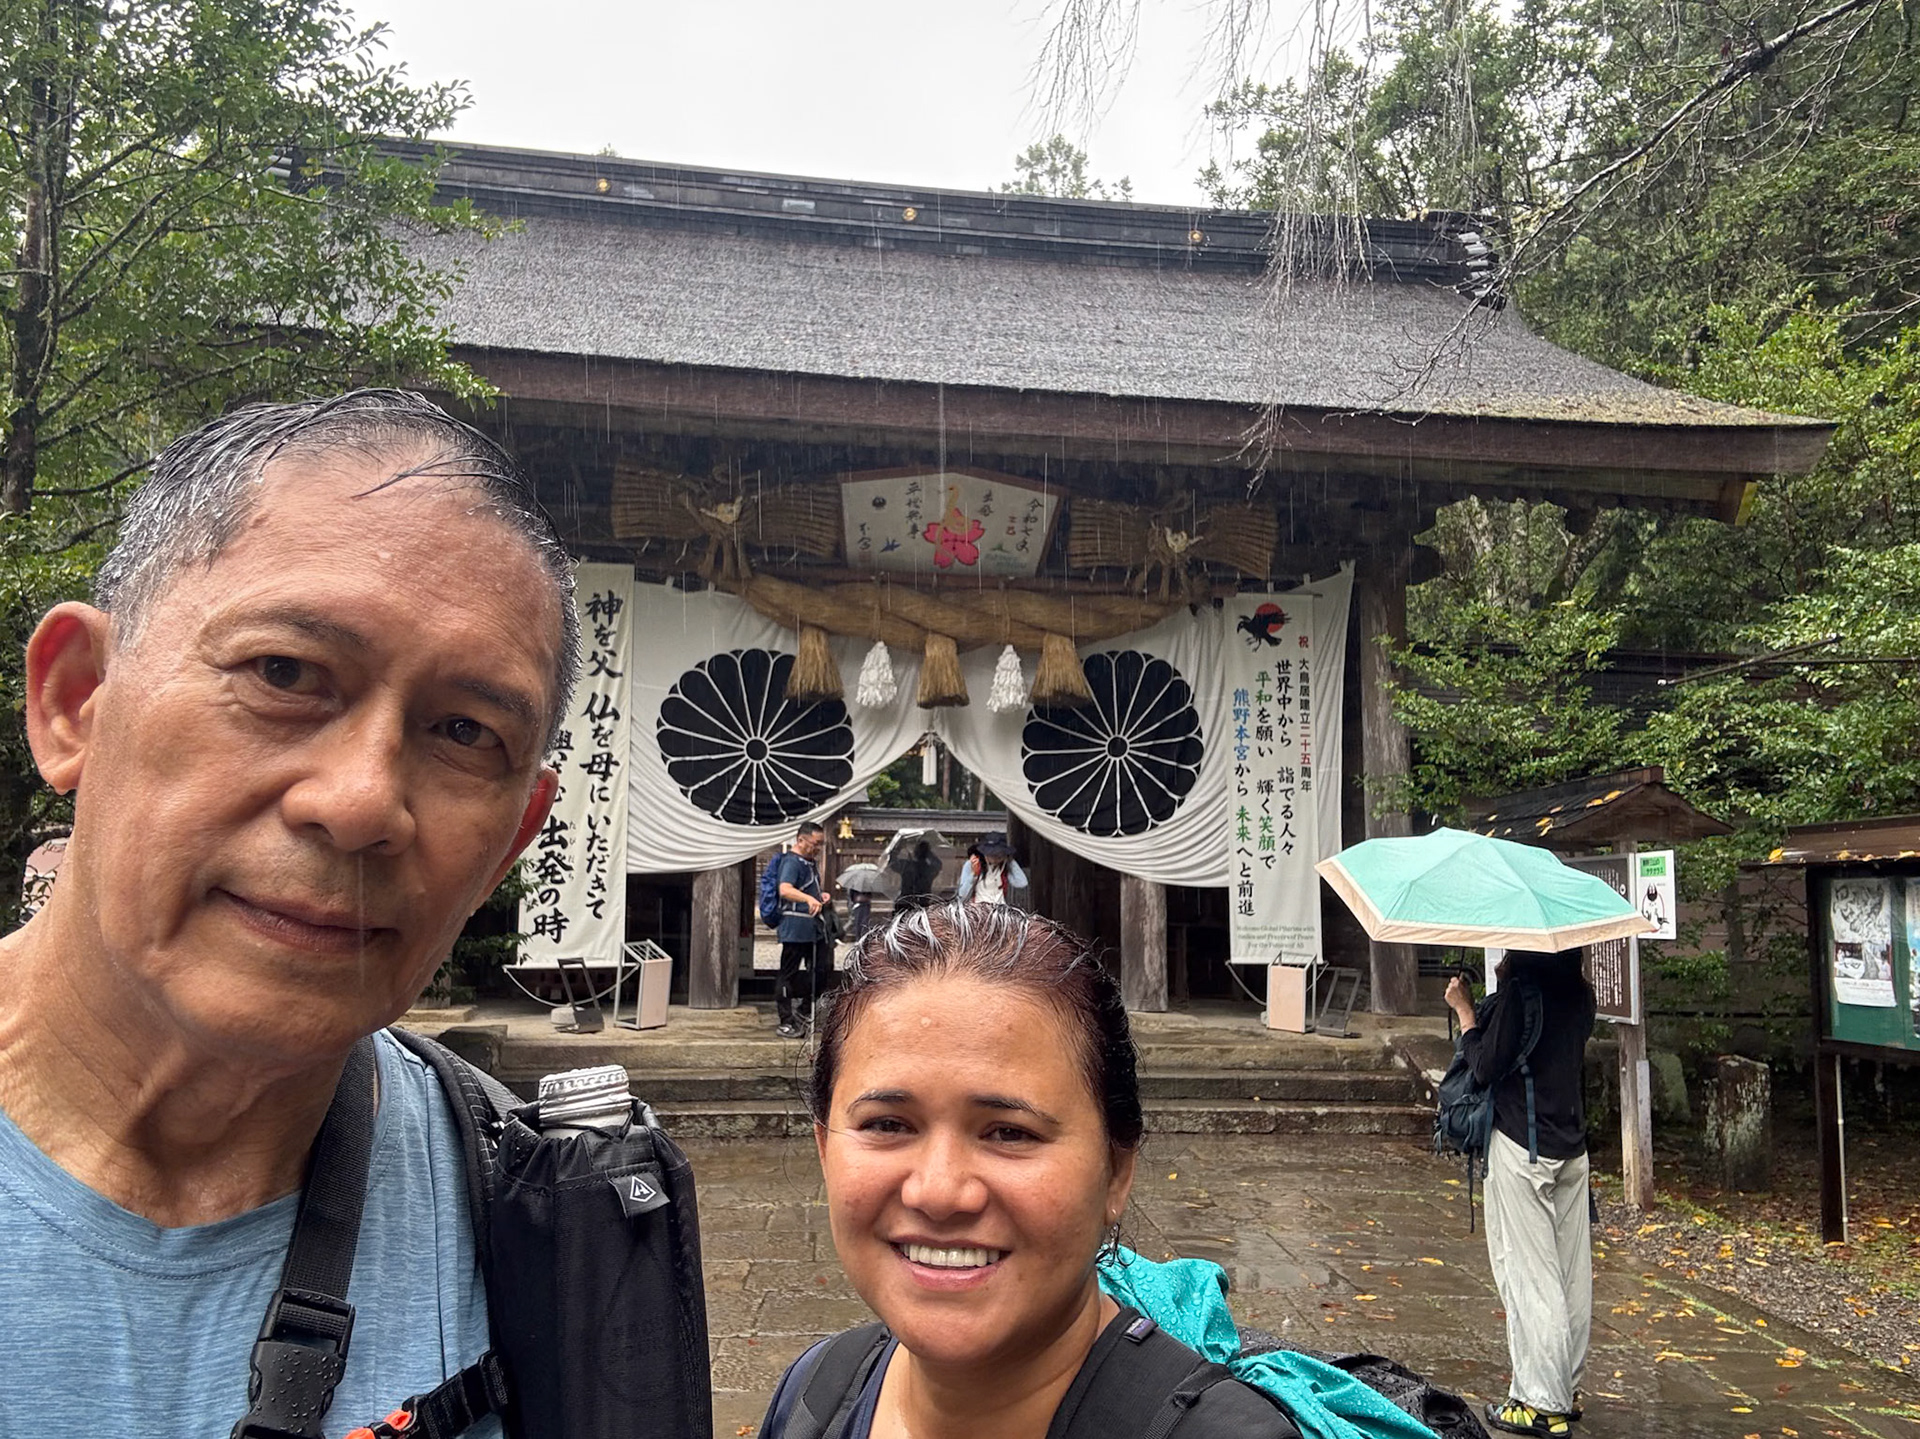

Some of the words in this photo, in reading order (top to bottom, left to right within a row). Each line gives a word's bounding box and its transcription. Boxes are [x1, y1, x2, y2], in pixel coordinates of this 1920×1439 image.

[584, 590, 623, 679] 神を父
[1298, 635, 1309, 649] 祝
[579, 692, 621, 802] 仏を母に
[1233, 688, 1251, 797] 熊野本宮から
[1255, 671, 1273, 758] 平和を願い
[1275, 660, 1295, 748] 世界中から
[1299, 657, 1312, 793] 大鳥居建立二十五周年
[1256, 779, 1276, 870] 輝く笑顔で
[1277, 766, 1297, 857] 詣でる人々
[532, 816, 574, 944] 出発の時
[586, 814, 611, 920] いただきて
[1235, 805, 1255, 917] 未来へと前進
